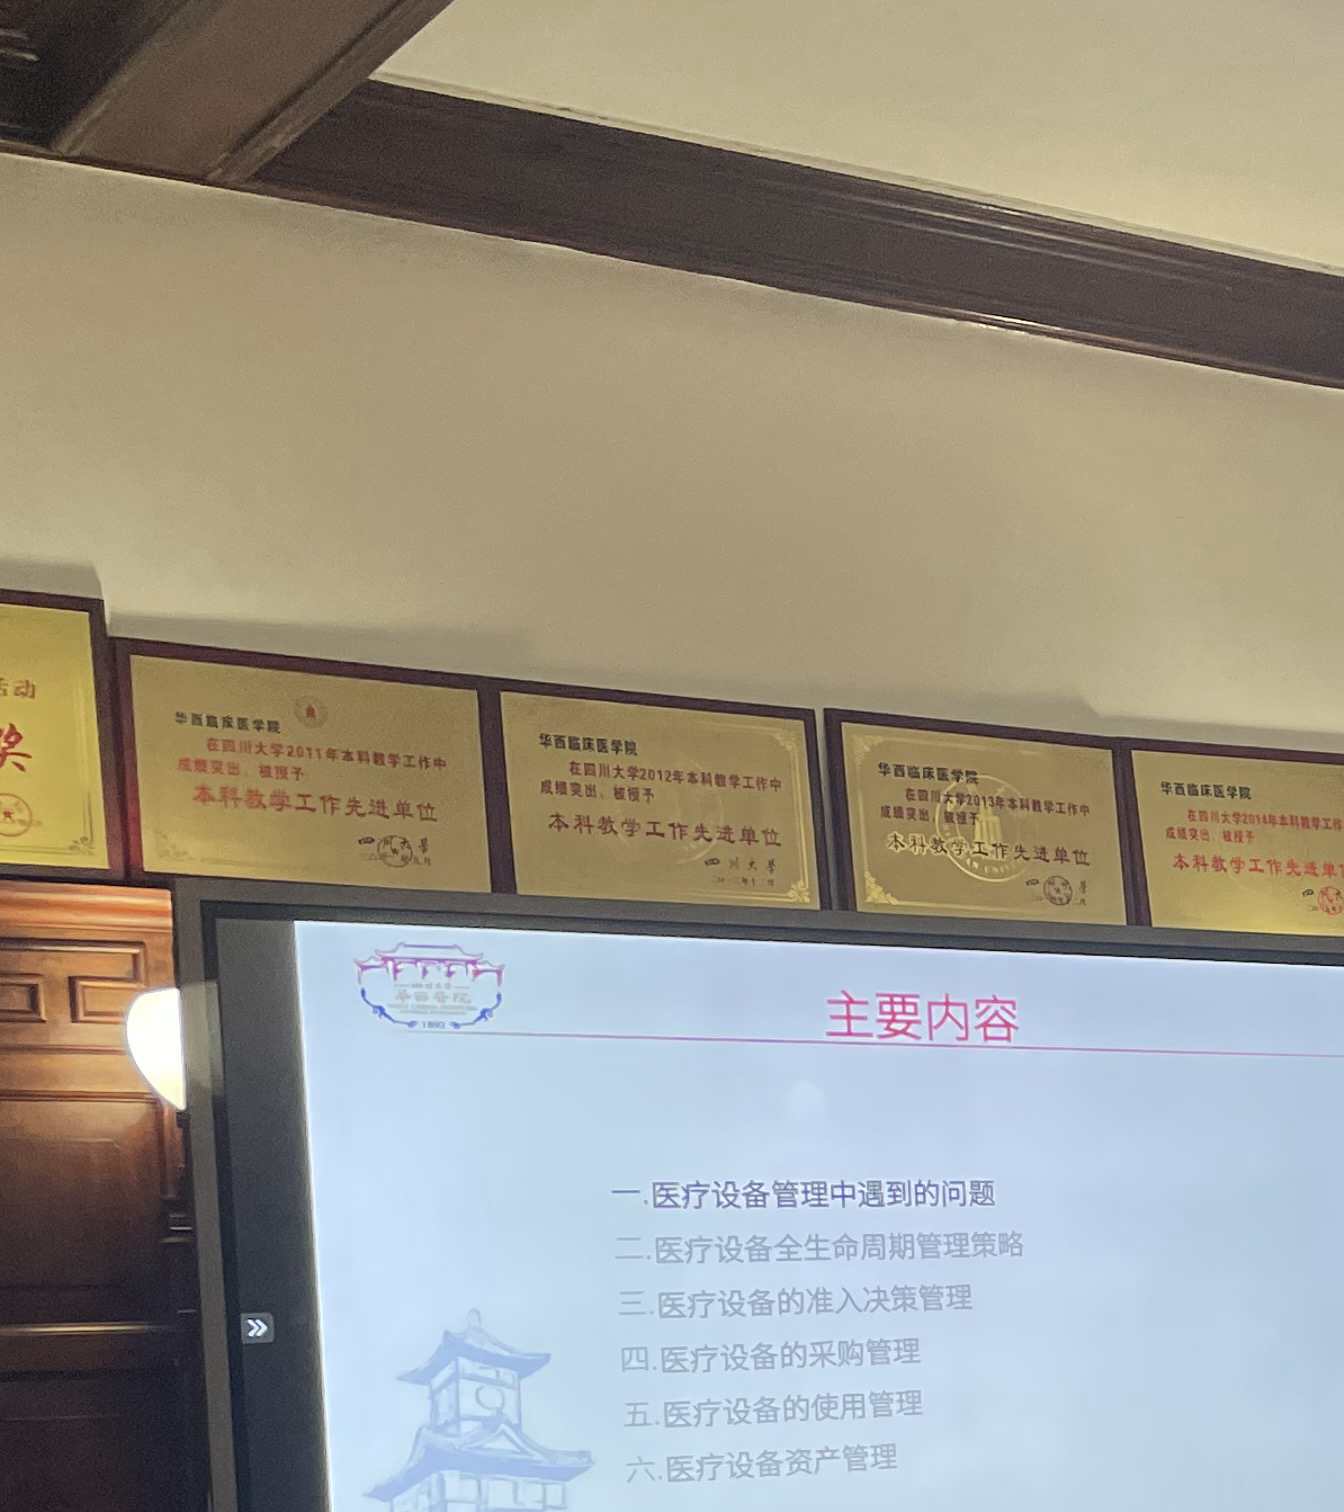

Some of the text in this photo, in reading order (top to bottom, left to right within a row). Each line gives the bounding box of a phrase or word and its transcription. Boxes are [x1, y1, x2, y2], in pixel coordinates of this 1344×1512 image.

[539, 733, 637, 756] 华西临床医学院
[878, 762, 979, 784] 华西临床医学院
[193, 783, 438, 822] 本科教学工作先进单位
[1160, 781, 1251, 800] 华西临床医学院
[548, 813, 782, 847] 本科教学工作先进单位
[888, 832, 1090, 866] 本科教学工作先进单位
[825, 989, 1020, 1043] 主要内容
